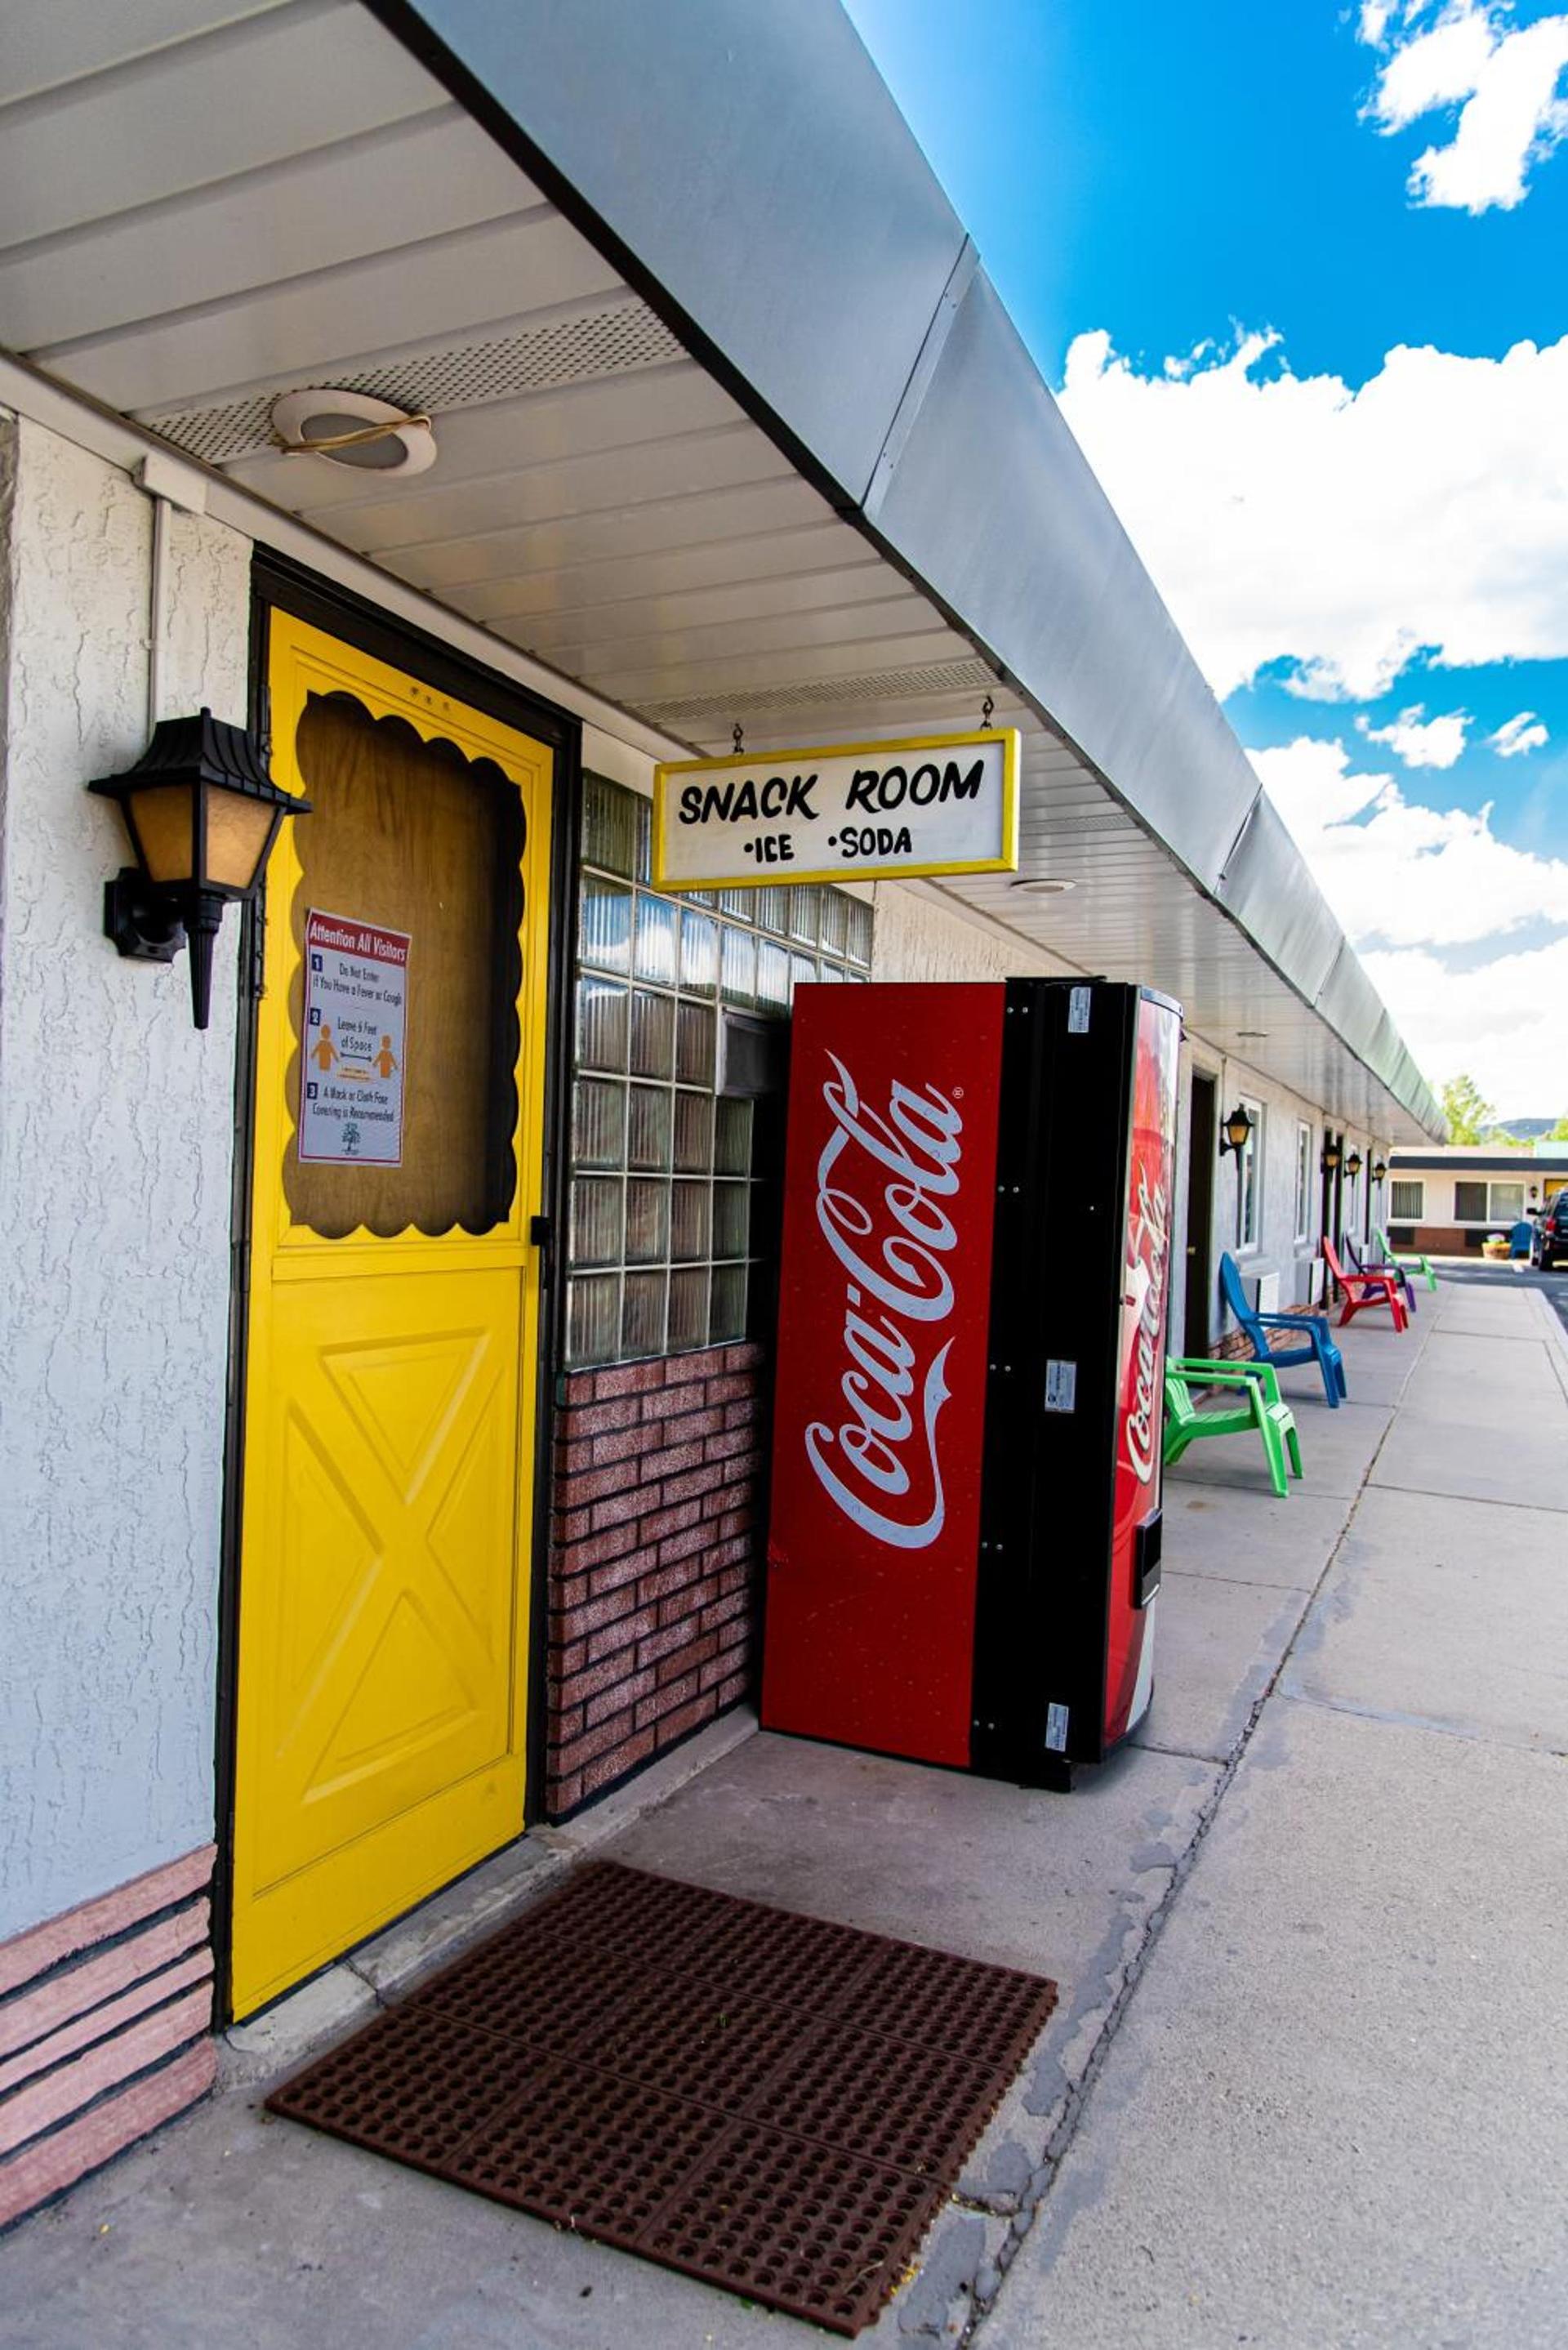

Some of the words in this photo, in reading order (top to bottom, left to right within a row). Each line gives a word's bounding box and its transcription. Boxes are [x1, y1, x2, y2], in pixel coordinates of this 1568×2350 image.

[679, 774, 820, 824] SNACK
[845, 759, 985, 814] ROOM
[755, 834, 795, 863] ICE
[840, 827, 913, 858] SODA
[310, 921, 355, 948] Attention
[357, 932, 372, 952] All
[373, 936, 406, 961] Visitors
[339, 962, 349, 977] Do
[350, 965, 361, 979] Not
[363, 967, 379, 983] Enter
[320, 976, 332, 990] You
[333, 979, 350, 994] Have
[351, 987, 356, 996] a
[357, 983, 375, 998] Fever
[383, 989, 403, 1007] Cough
[337, 1016, 356, 1031] Leave
[363, 1020, 377, 1036] Feet
[349, 1037, 372, 1052] Space
[330, 1086, 347, 1100] Mask
[356, 1090, 374, 1103] Cloth
[313, 1103, 341, 1120] Covering
[350, 1105, 394, 1122] Recommended
[804, 1049, 964, 1550] Coca-Cola
